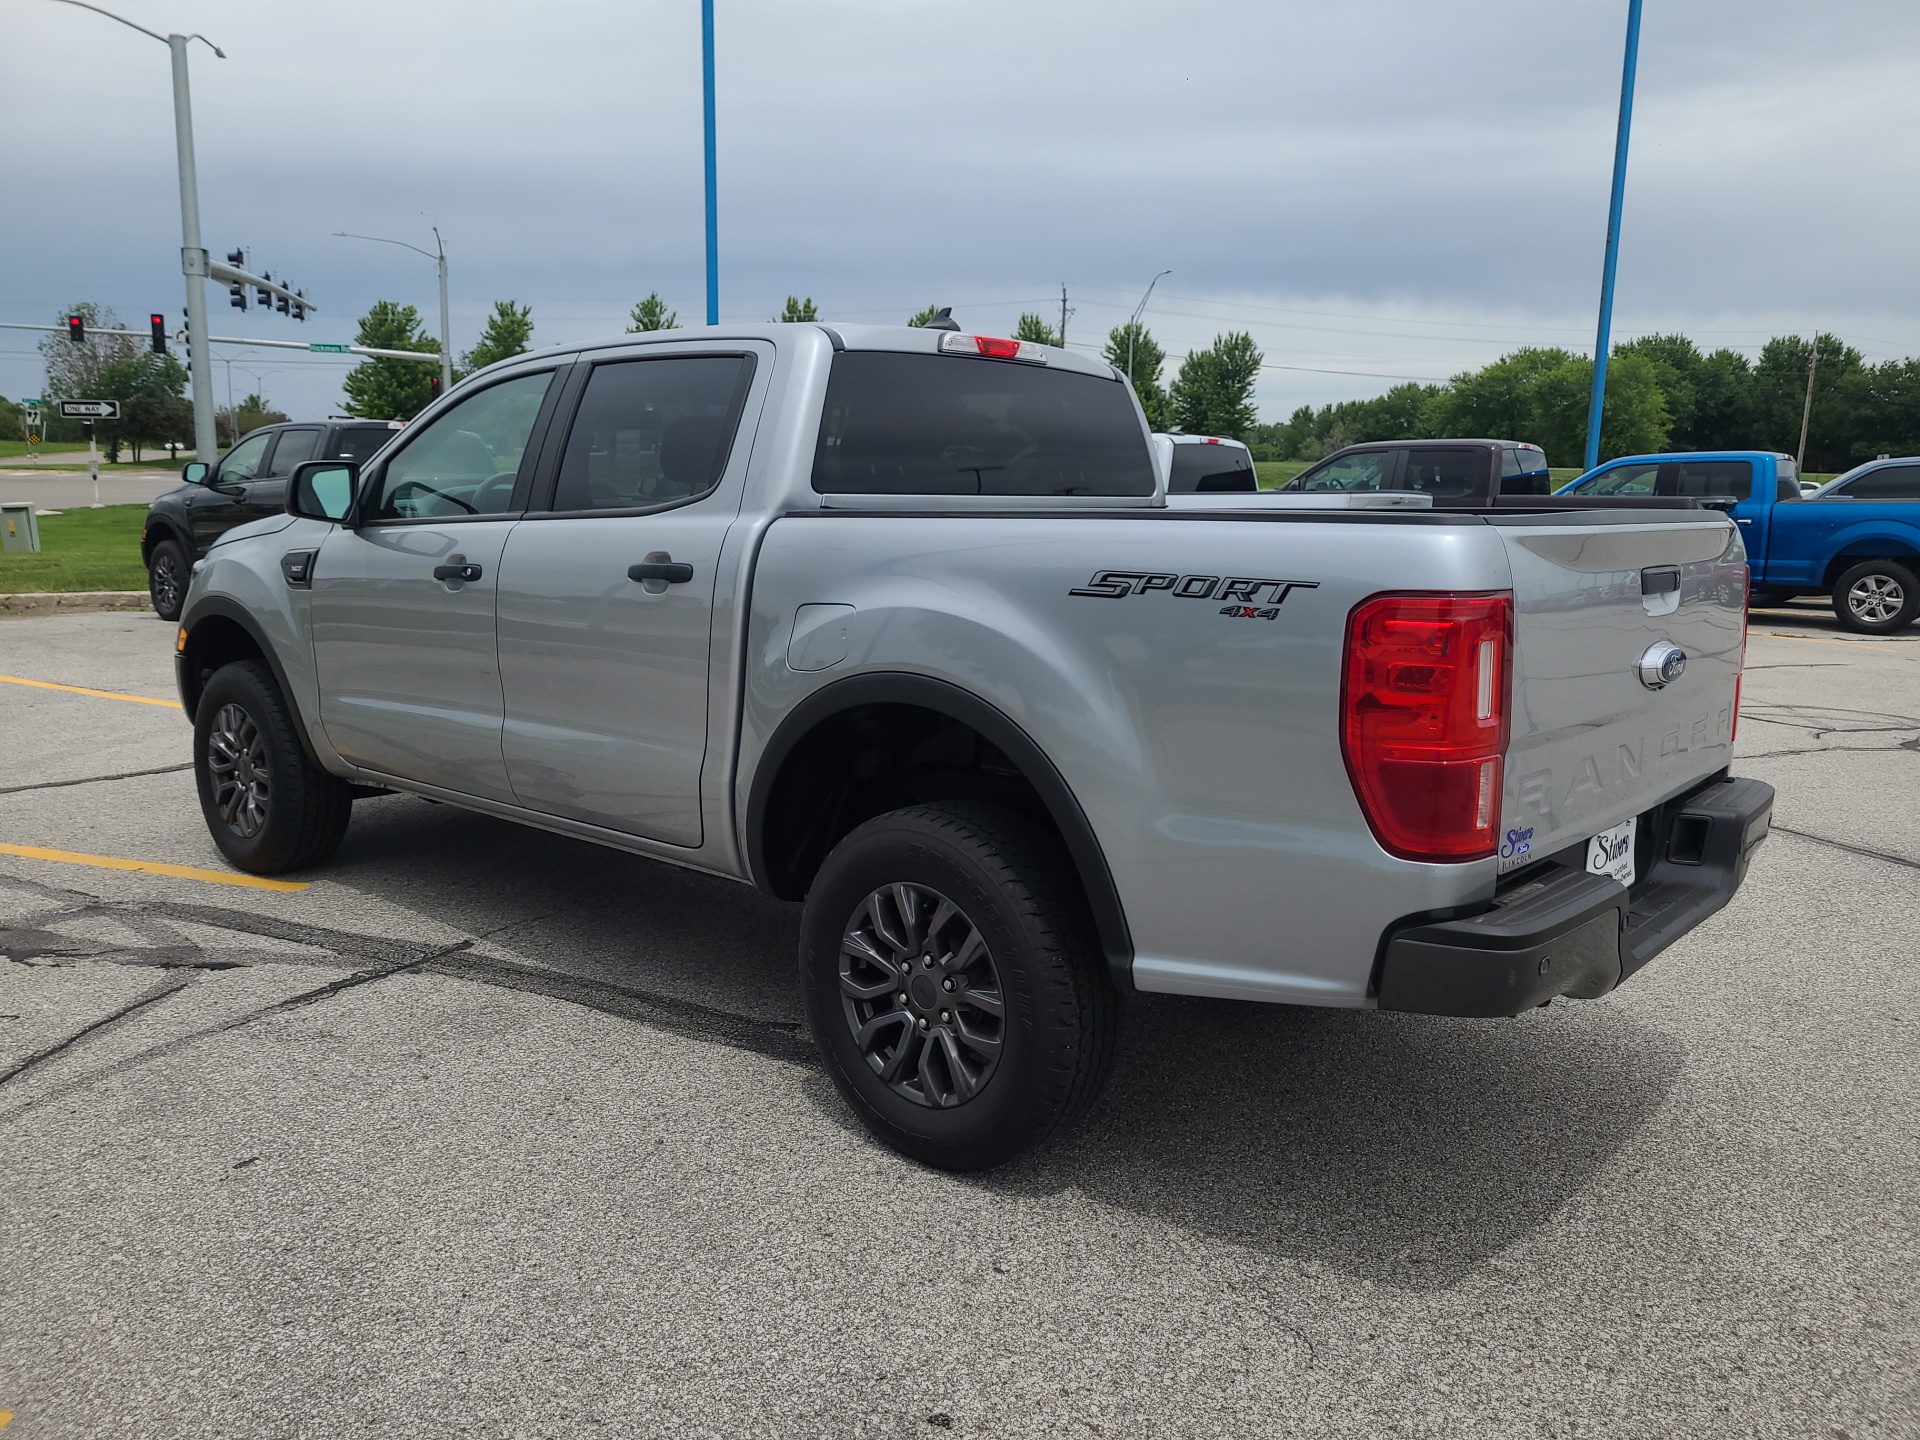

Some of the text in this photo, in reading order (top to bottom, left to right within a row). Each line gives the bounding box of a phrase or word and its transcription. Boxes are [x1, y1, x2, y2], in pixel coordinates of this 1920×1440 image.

[66, 405, 100, 413] ONE WAY
[1067, 569, 1320, 604] SPORT
[1668, 653, 1685, 676] Ford
[1513, 701, 1732, 821] RANGER
[1500, 826, 1534, 858] Stivers
[1593, 833, 1630, 869] Stivers
[1504, 853, 1532, 869] LINCOLN
[1614, 861, 1628, 876] Certified
